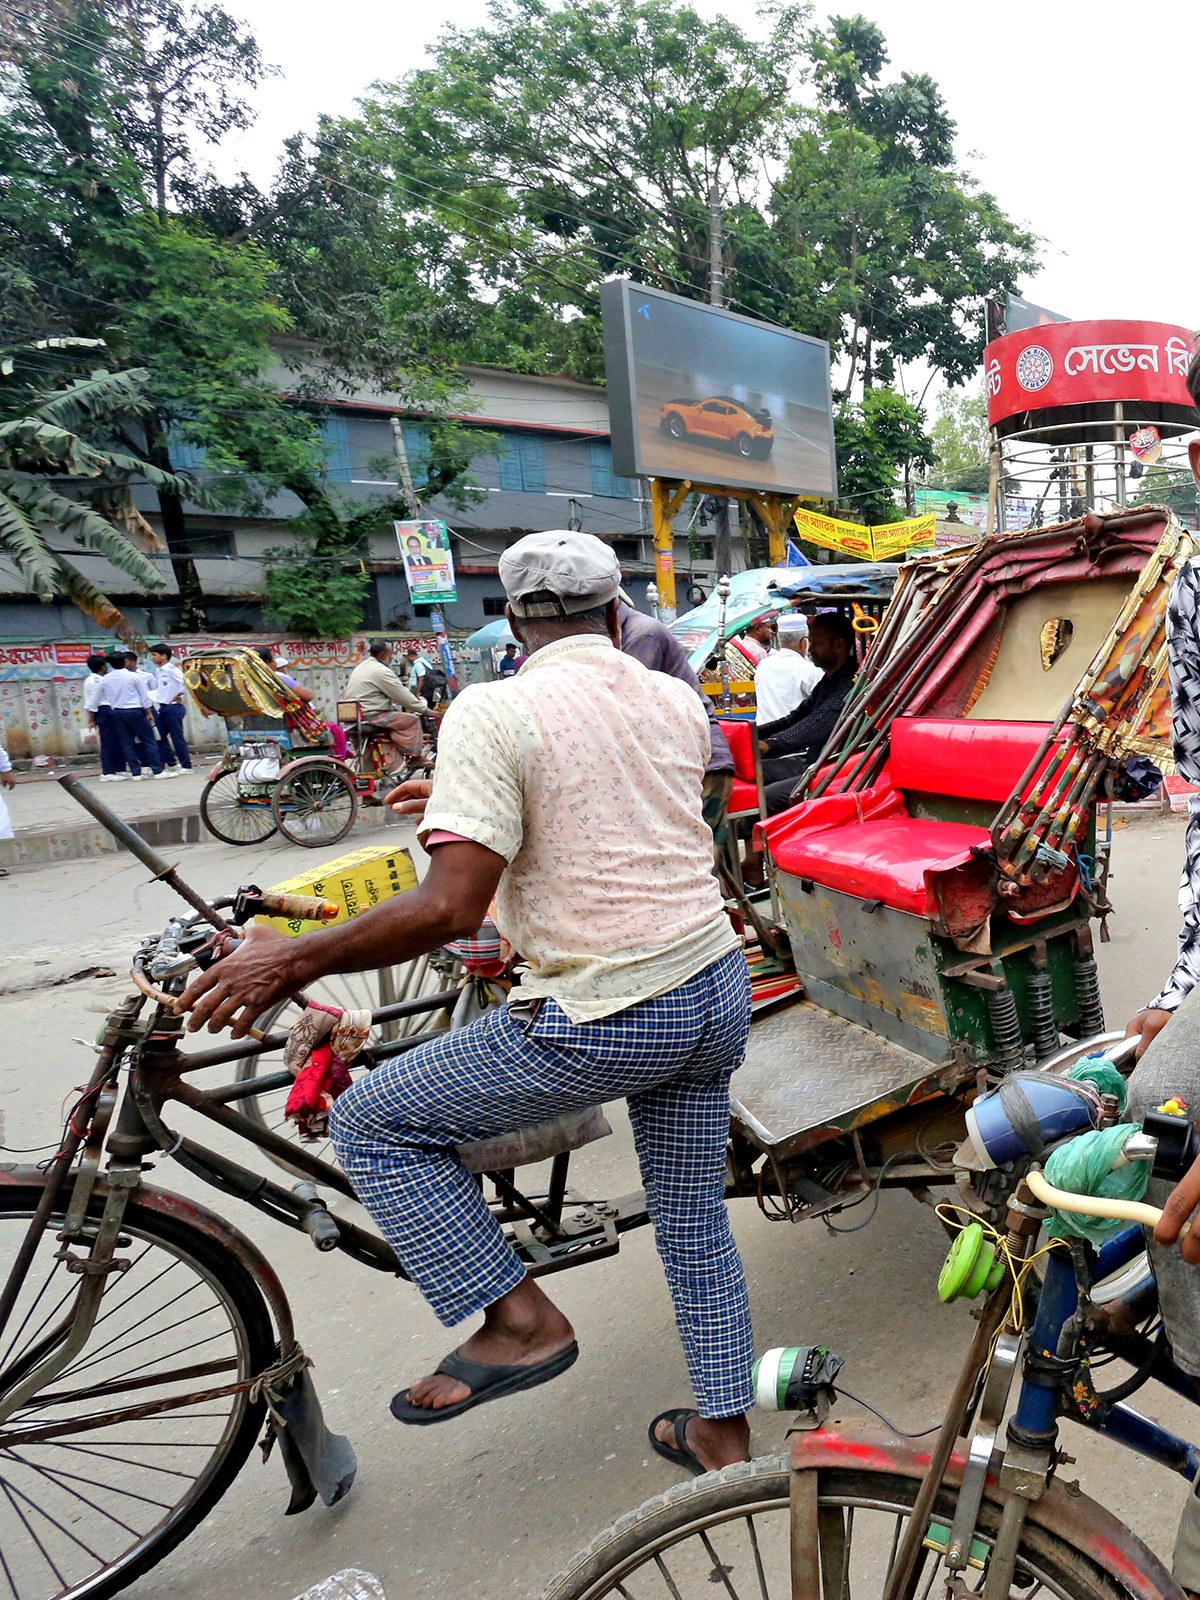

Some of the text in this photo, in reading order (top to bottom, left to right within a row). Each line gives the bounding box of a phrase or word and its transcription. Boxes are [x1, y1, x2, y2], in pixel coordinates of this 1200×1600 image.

[1065, 336, 1194, 376] সেভেন রি
[1021, 374, 1048, 388] CEMENT
[340, 877, 358, 916] সহায়তা
